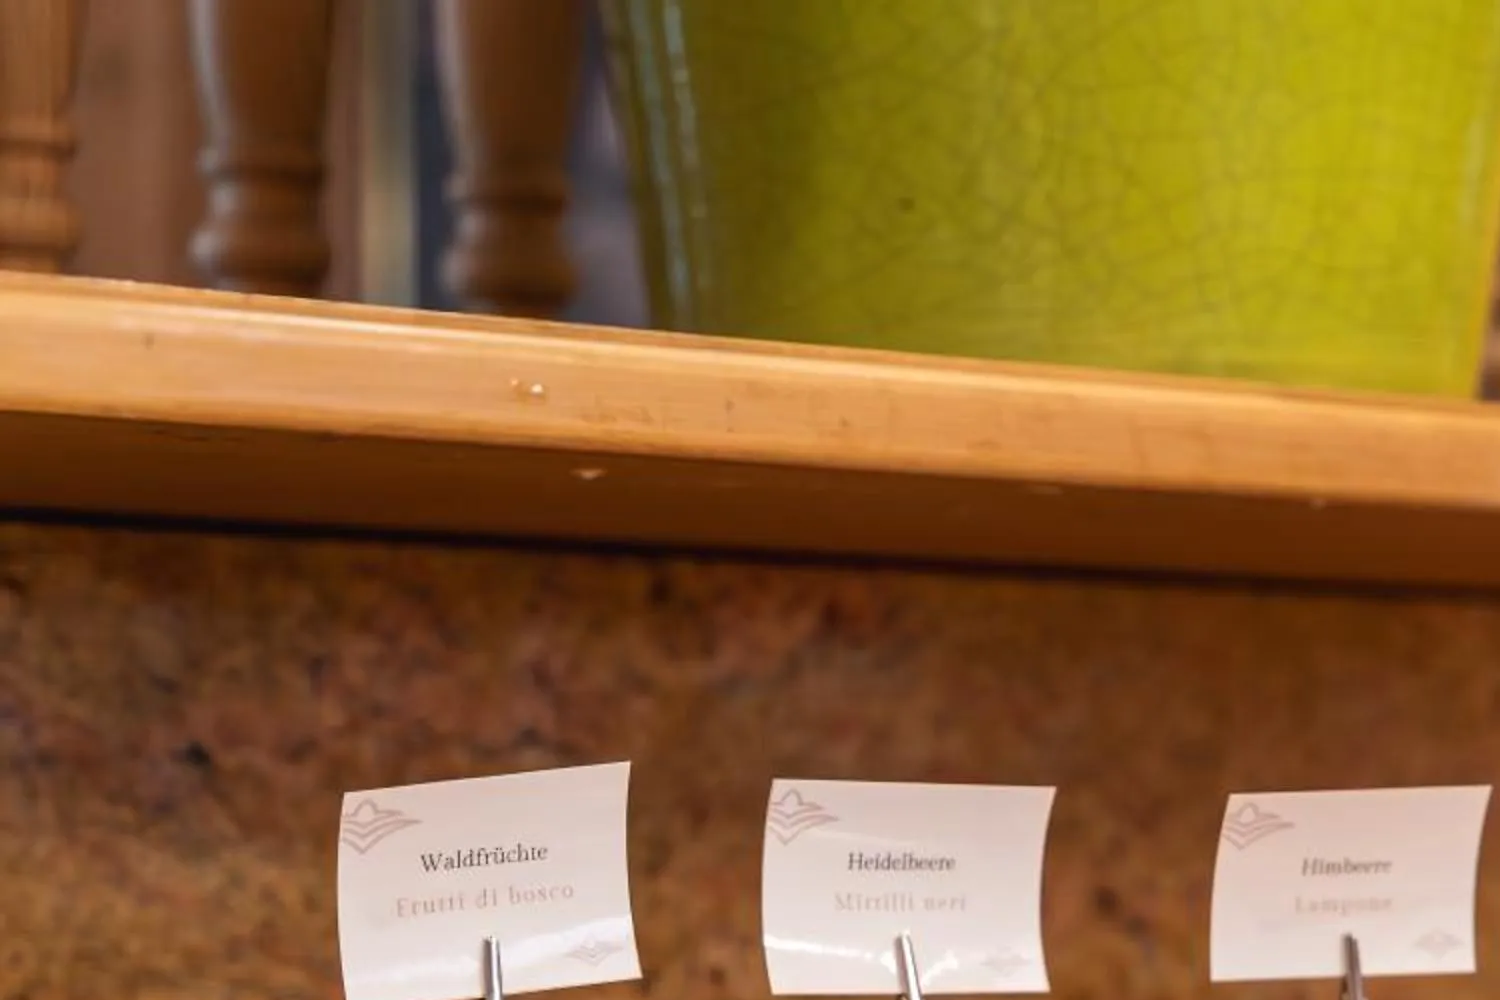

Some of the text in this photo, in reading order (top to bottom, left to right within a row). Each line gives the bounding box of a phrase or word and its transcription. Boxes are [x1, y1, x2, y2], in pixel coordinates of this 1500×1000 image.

[420, 843, 549, 873] Waldfrüchte
[848, 852, 955, 871] Heidelbeere
[1302, 857, 1393, 876] Himbeere
[395, 886, 575, 918] Frutti di bosco
